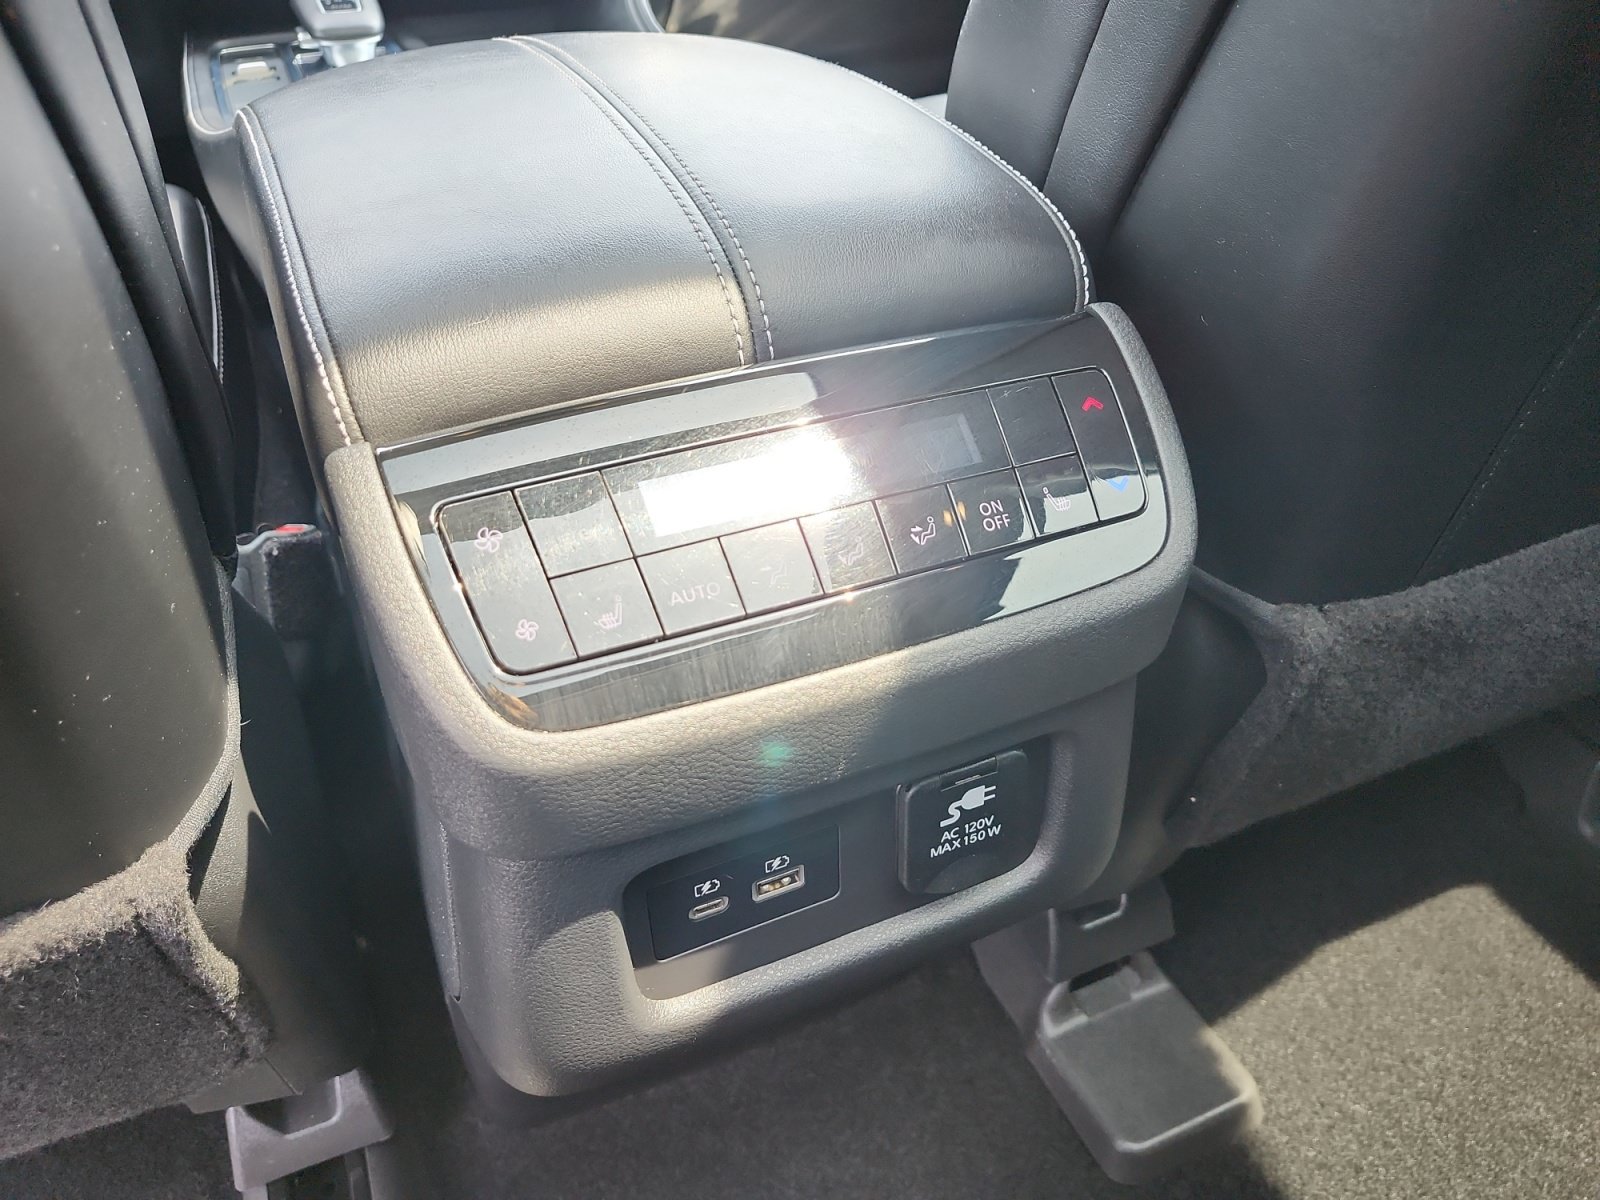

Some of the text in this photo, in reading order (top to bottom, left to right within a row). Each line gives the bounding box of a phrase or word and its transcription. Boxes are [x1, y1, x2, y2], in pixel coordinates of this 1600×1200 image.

[979, 499, 1004, 516] ON
[982, 513, 1010, 532] OFF
[670, 582, 721, 607] AUTO
[940, 815, 994, 843] AC 120V
[930, 838, 961, 858] MAX
